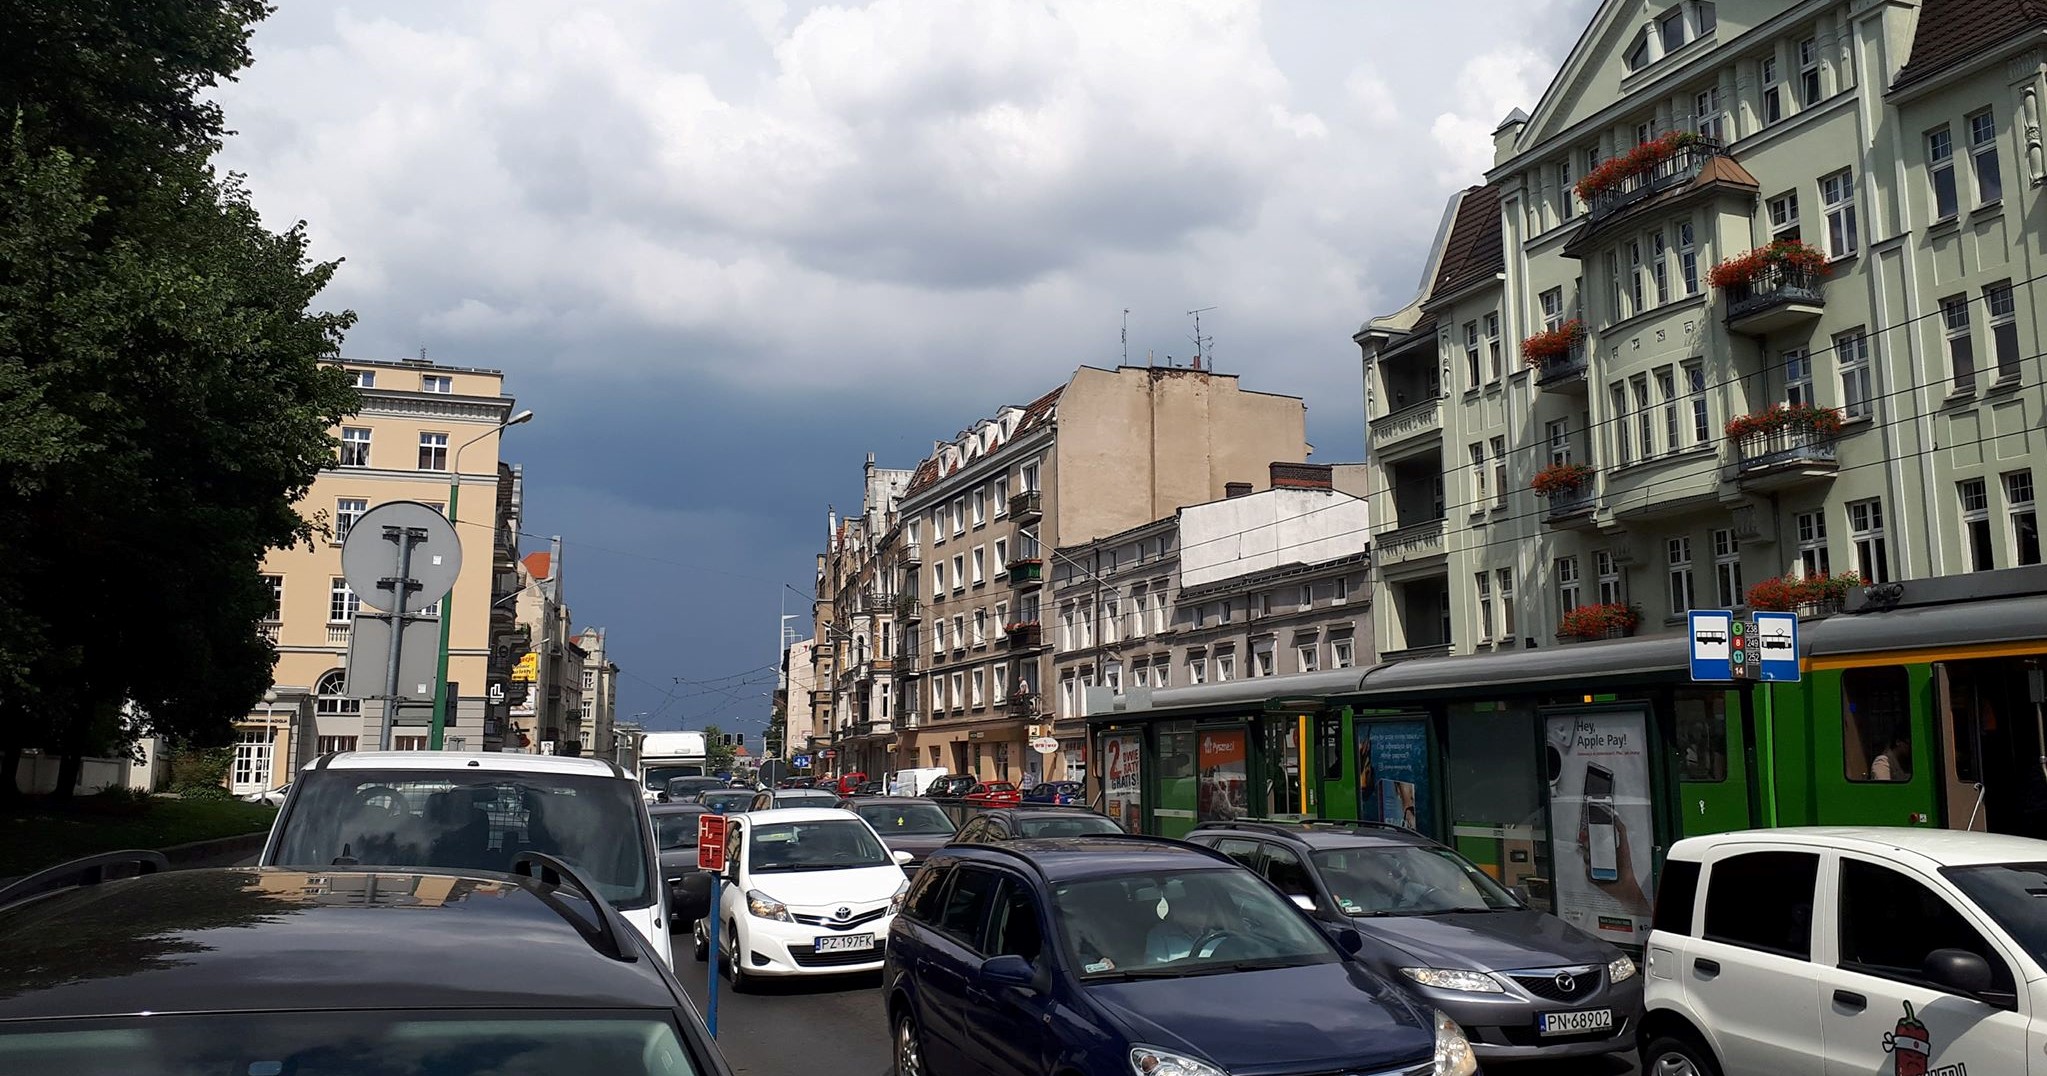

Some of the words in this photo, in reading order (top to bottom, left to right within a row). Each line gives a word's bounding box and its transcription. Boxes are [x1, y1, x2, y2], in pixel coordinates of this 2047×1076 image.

[1745, 624, 1758, 633] 238
[1747, 639, 1759, 647] 249
[1749, 653, 1760, 662] 252
[1735, 667, 1744, 675] 14
[1576, 720, 1596, 734] Hey,
[1577, 734, 1604, 749] Apple
[1607, 733, 1627, 749] Pay!
[1108, 740, 1120, 780] 2
[1111, 772, 1140, 790] GRATIS!
[1547, 1014, 1567, 1031] PN
[1571, 1011, 1610, 1029] 68902
